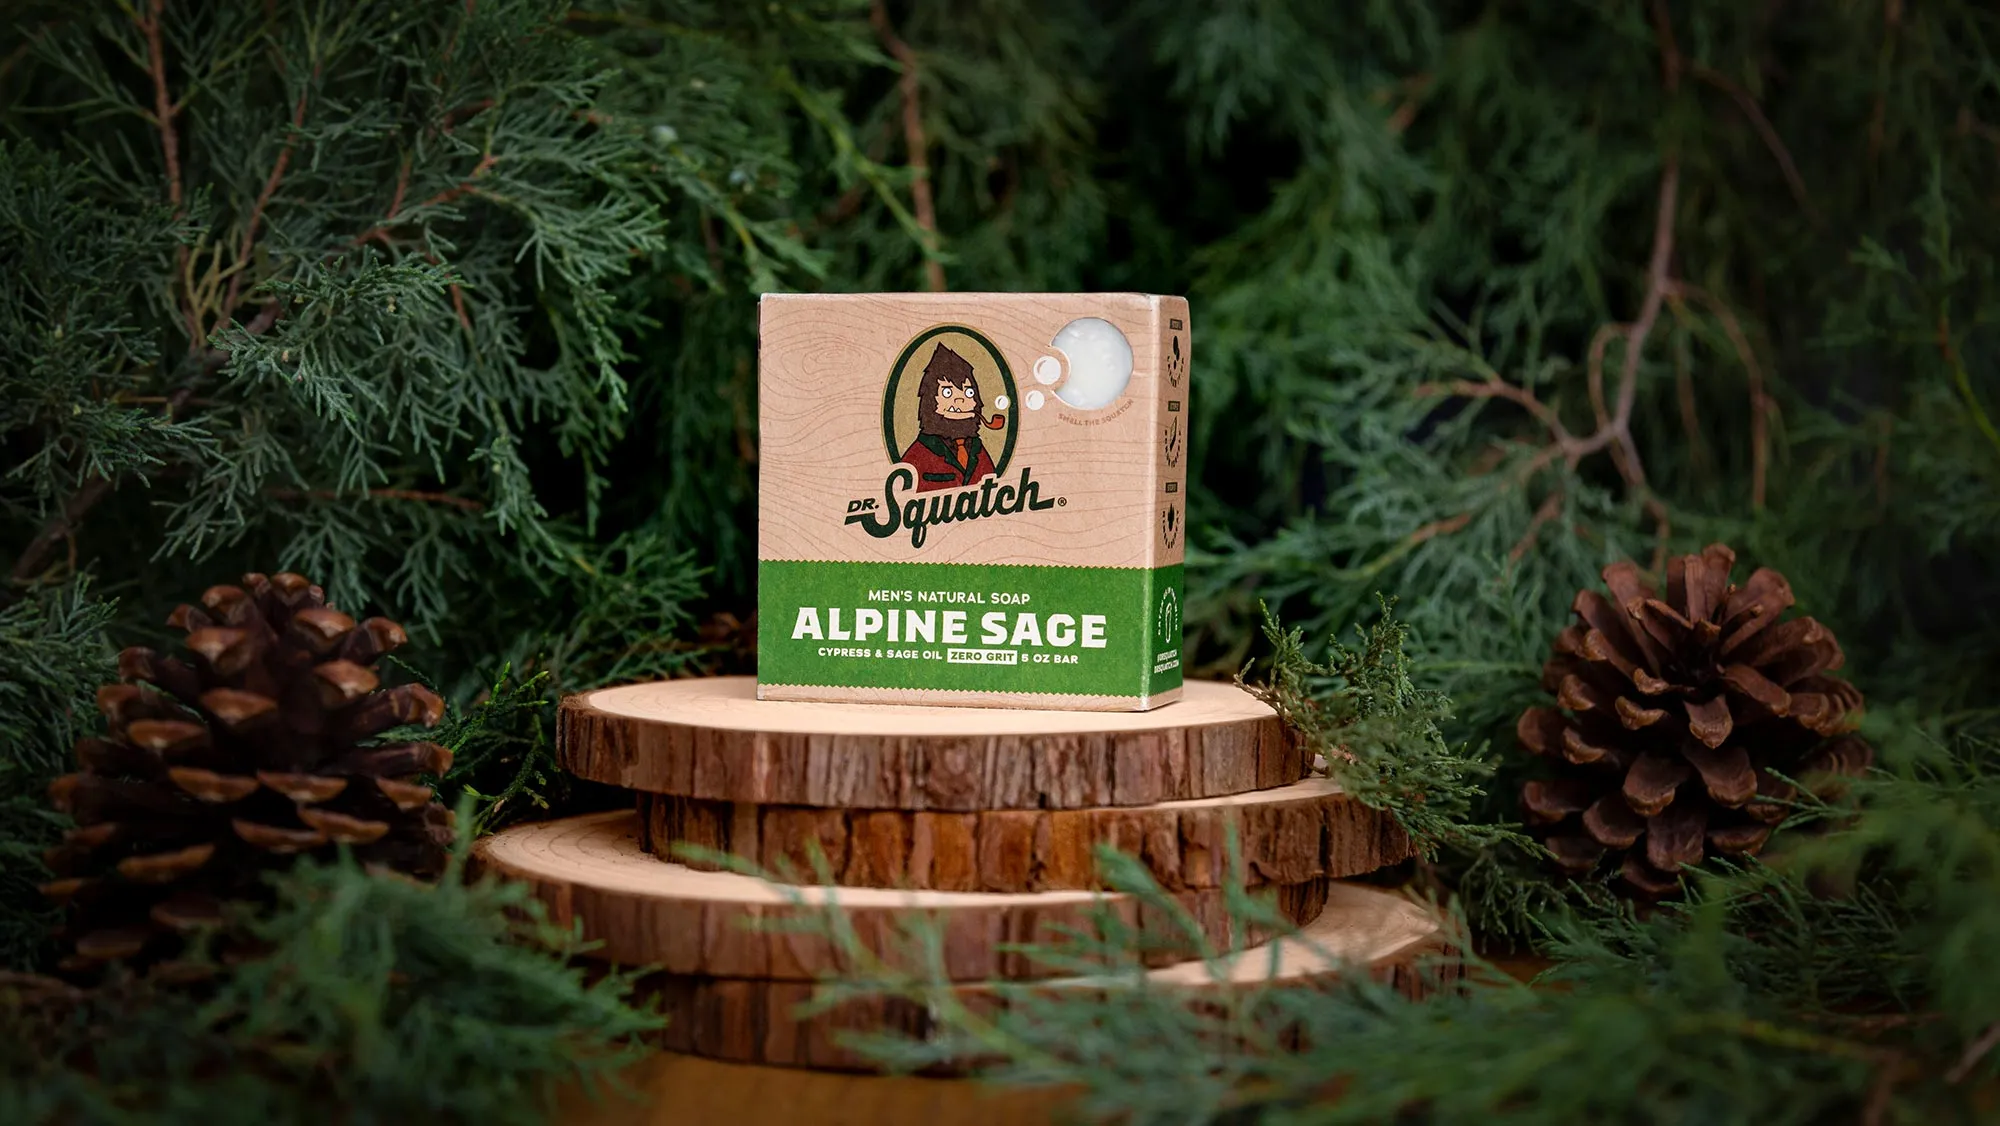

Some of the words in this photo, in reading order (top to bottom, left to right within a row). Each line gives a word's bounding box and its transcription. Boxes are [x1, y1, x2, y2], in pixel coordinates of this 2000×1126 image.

[844, 467, 1055, 549] Squatch
[847, 498, 880, 512] DR.
[868, 590, 912, 602] MEN'S
[918, 591, 985, 604] NATURAL
[991, 593, 1031, 605] SOAP
[791, 607, 968, 643] ALPINE
[981, 611, 1107, 648] SAGE
[818, 648, 871, 658] CYPRESS
[875, 650, 883, 658] &
[887, 650, 919, 659] SAGE
[923, 651, 942, 660] OIL
[951, 652, 982, 661] ZERO
[986, 653, 1014, 662] GRIT
[1021, 654, 1029, 662] 5
[1033, 654, 1050, 663] OZ
[1054, 655, 1079, 664] BAR
